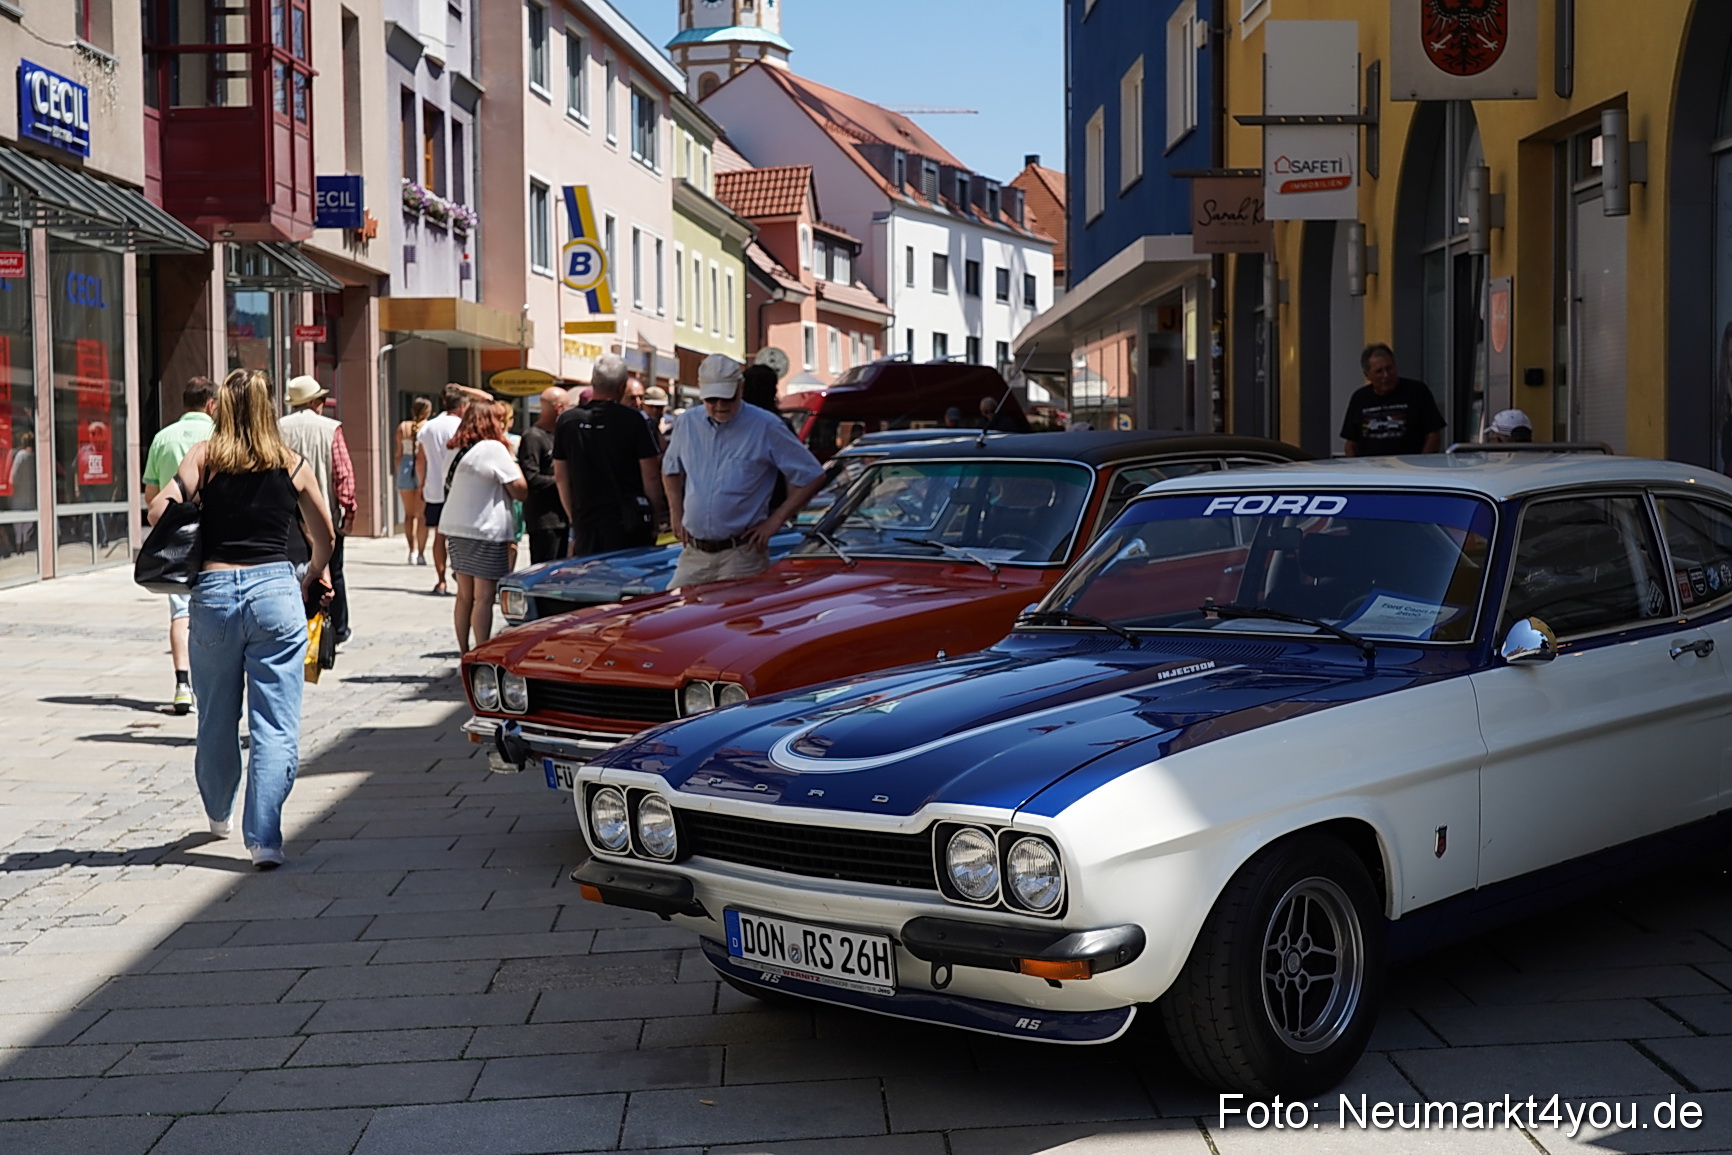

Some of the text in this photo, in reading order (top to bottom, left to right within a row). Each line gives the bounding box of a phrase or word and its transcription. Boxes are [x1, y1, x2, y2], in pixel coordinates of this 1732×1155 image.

[31, 70, 88, 131] CECIL
[1290, 179, 1343, 190] IMMOBILIEN
[1198, 197, 1251, 226] Sarah
[569, 252, 592, 276] B
[67, 271, 107, 309] CECIL
[1202, 495, 1348, 516] FORD
[1381, 602, 1403, 611] Ford
[1157, 660, 1216, 680] INJECTION
[554, 764, 574, 789] FÜ
[741, 917, 890, 980] DON RS 26H
[760, 972, 782, 984] RS
[782, 969, 821, 983] WERNITZ
[1015, 1017, 1042, 1030] RS
